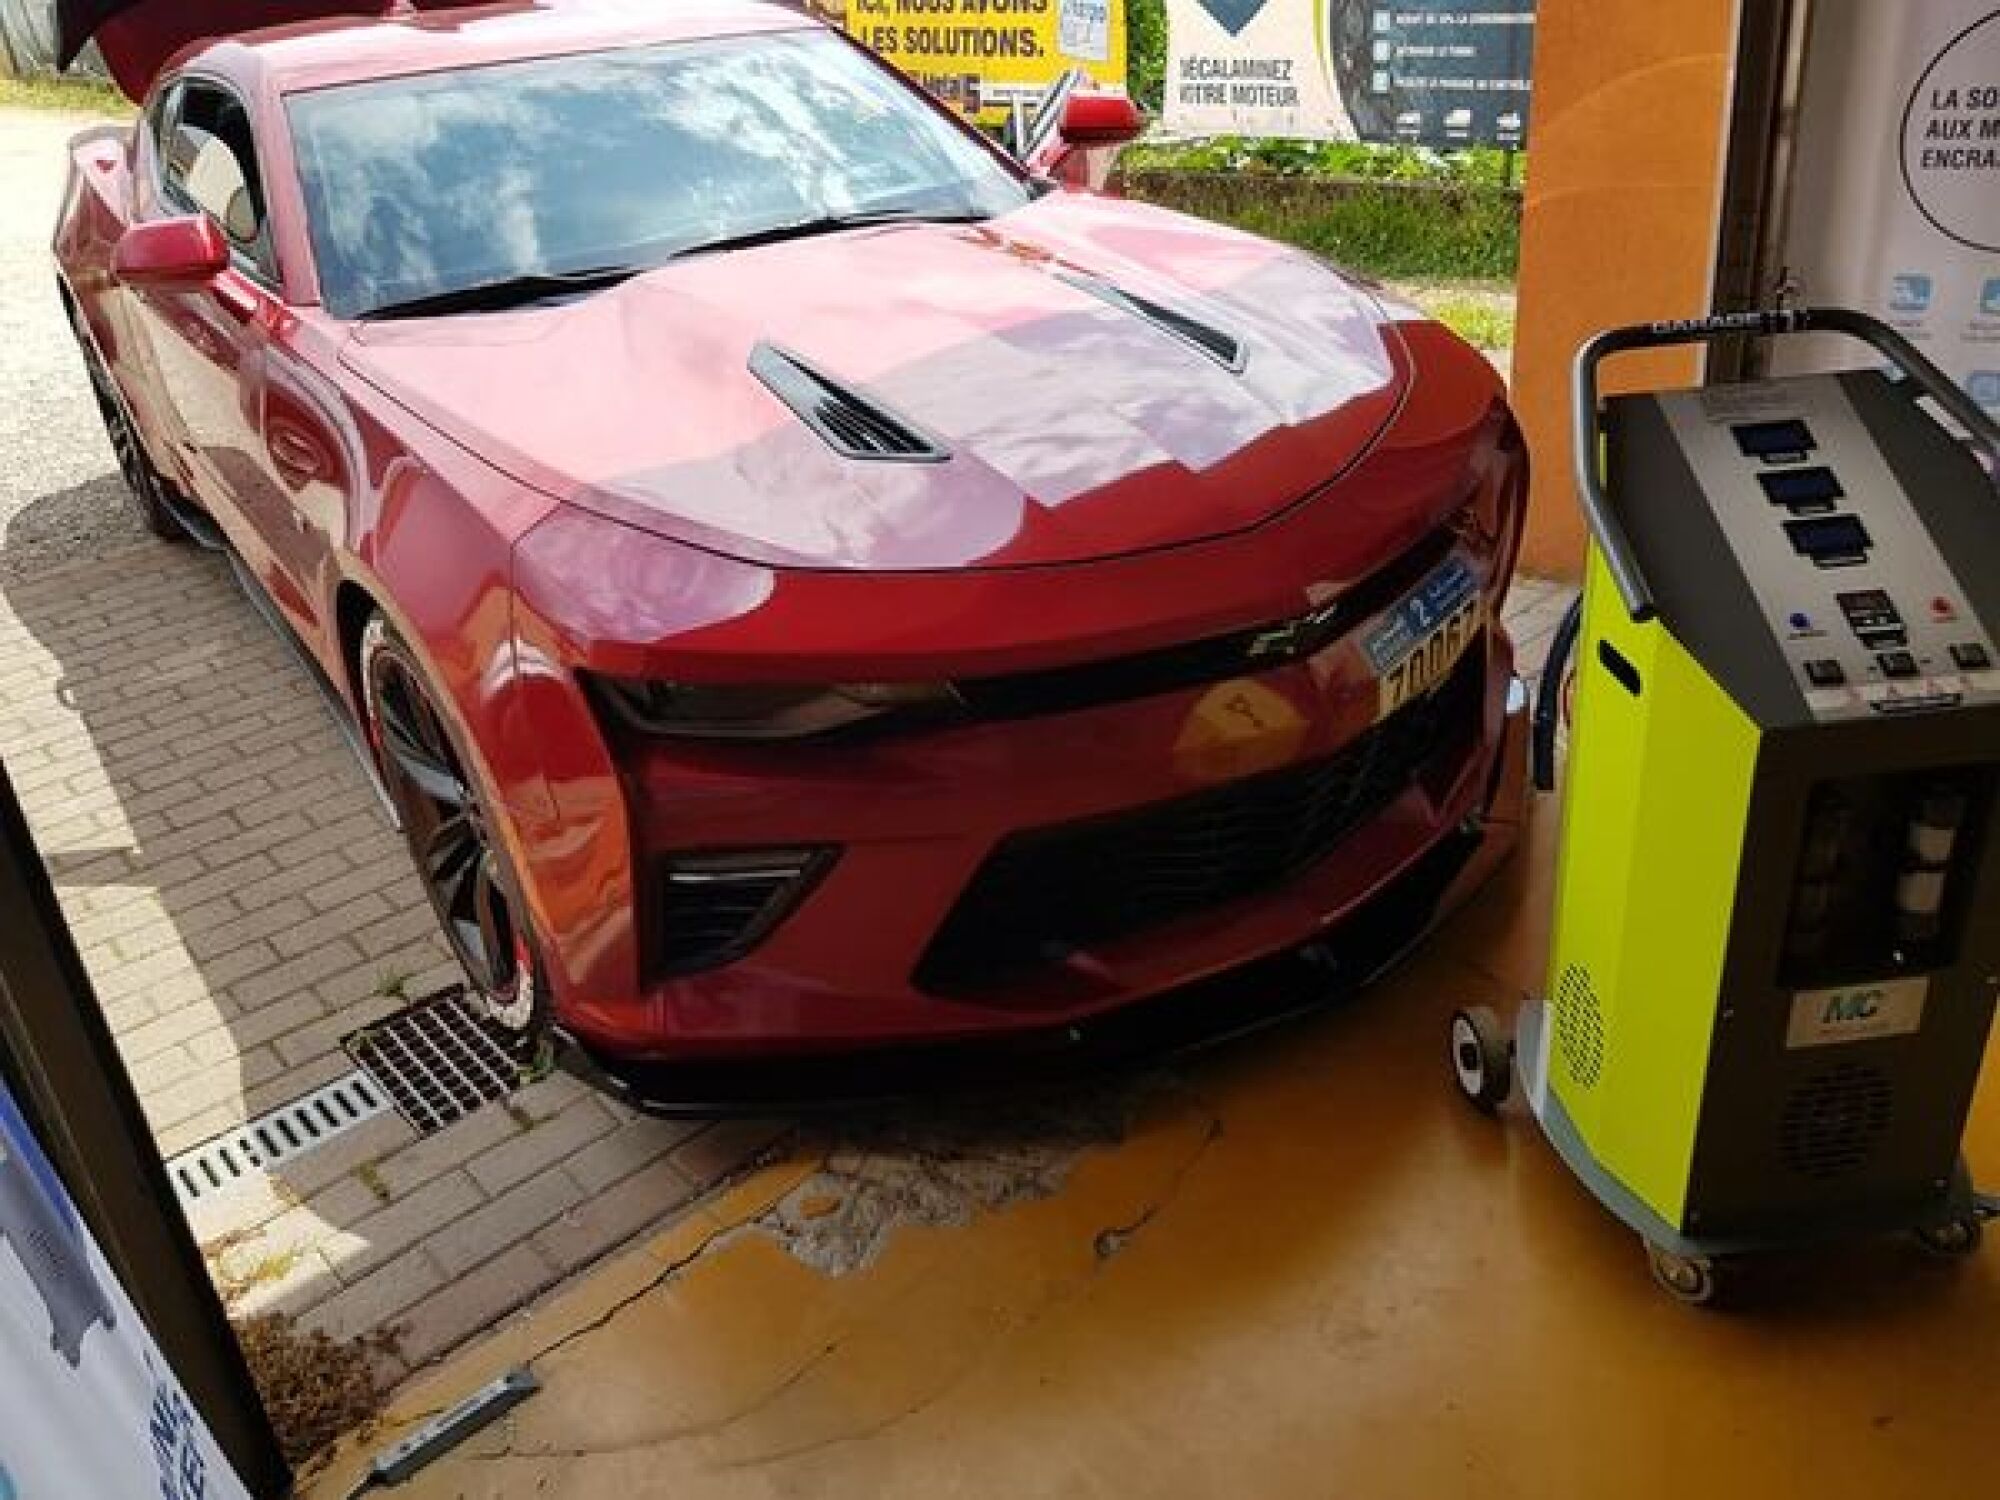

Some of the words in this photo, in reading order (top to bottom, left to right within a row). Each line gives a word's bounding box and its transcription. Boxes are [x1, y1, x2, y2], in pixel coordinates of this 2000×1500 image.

[862, 26, 898, 54] LES
[905, 26, 1045, 57] SOLUTIONS.
[1230, 83, 1300, 107] MOTEUR
[1930, 88, 1958, 110] LA
[1925, 118, 1972, 140] AUX
